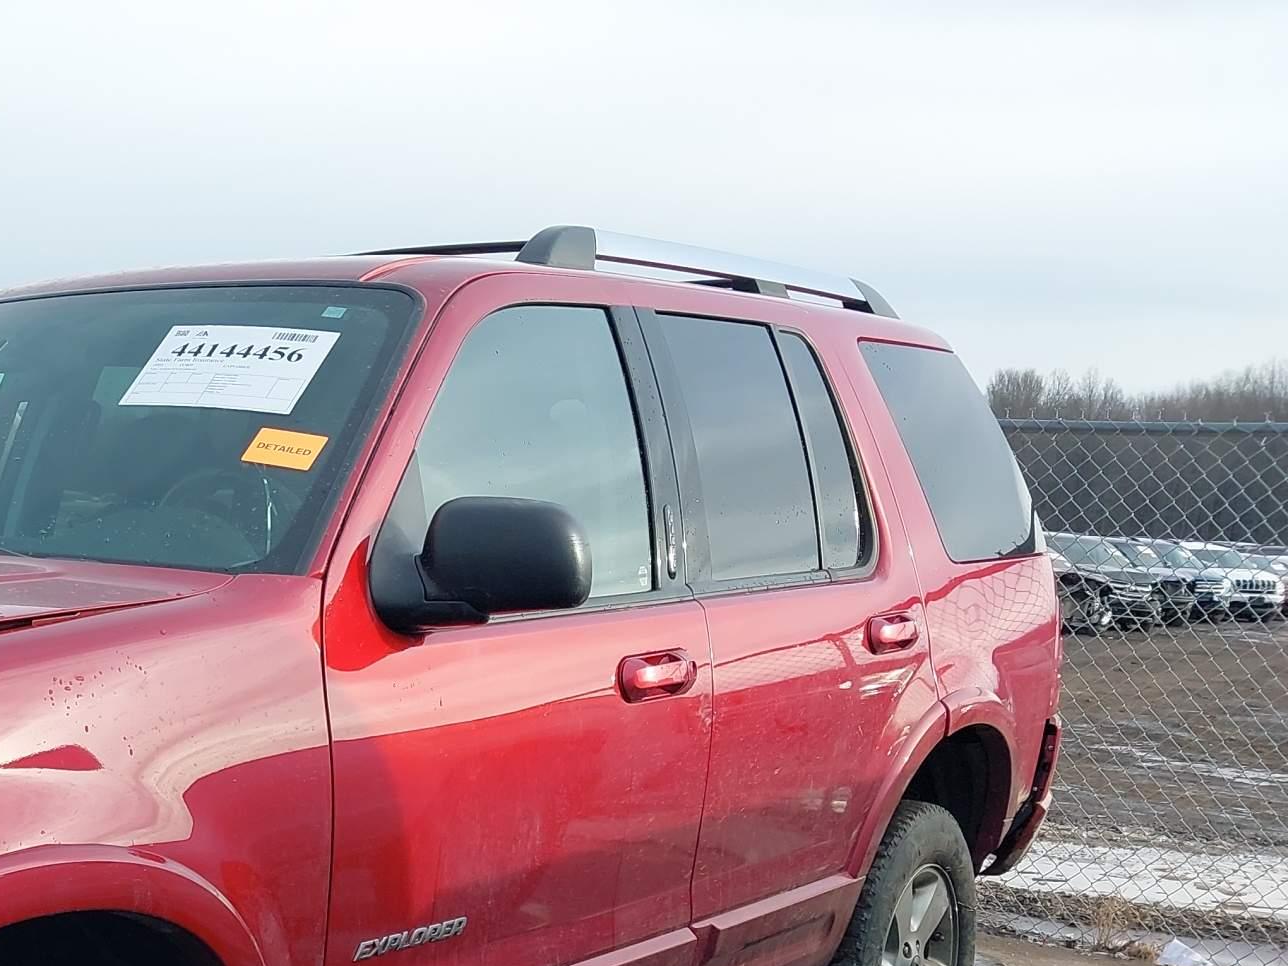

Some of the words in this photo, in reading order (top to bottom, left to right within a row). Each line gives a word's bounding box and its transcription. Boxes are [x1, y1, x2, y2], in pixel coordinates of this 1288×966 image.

[171, 341, 308, 363] 44144456
[256, 440, 312, 457] DETAILED
[352, 916, 468, 962] EXPLORER
